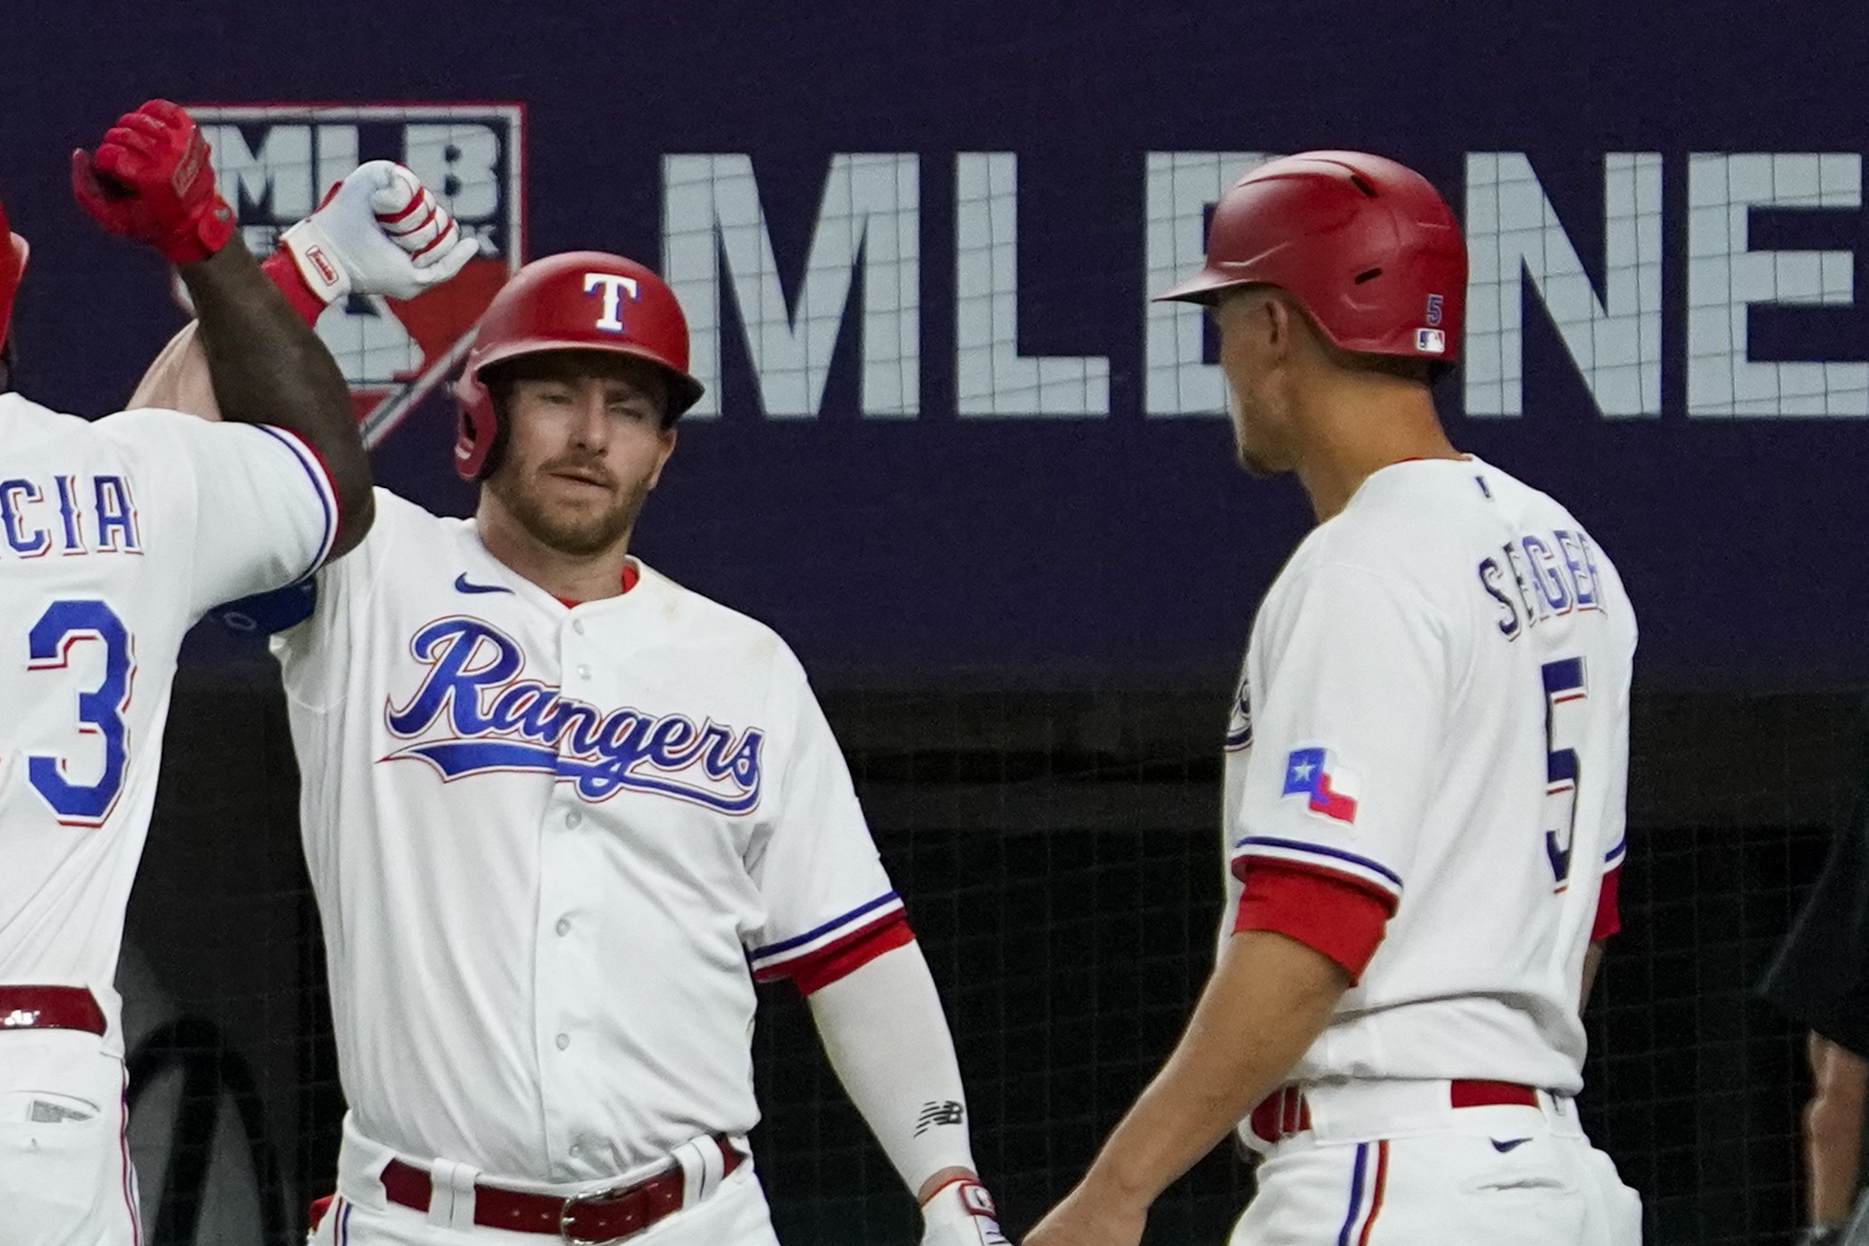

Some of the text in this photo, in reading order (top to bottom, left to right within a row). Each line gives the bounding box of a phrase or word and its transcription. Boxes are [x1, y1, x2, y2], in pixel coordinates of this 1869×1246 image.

[200, 123, 499, 221] MLB
[583, 272, 638, 333] T
[1426, 293, 1444, 327] 5
[1464, 152, 1869, 419] NE
[381, 614, 766, 816] Rangers
[1541, 656, 1588, 893] 5
